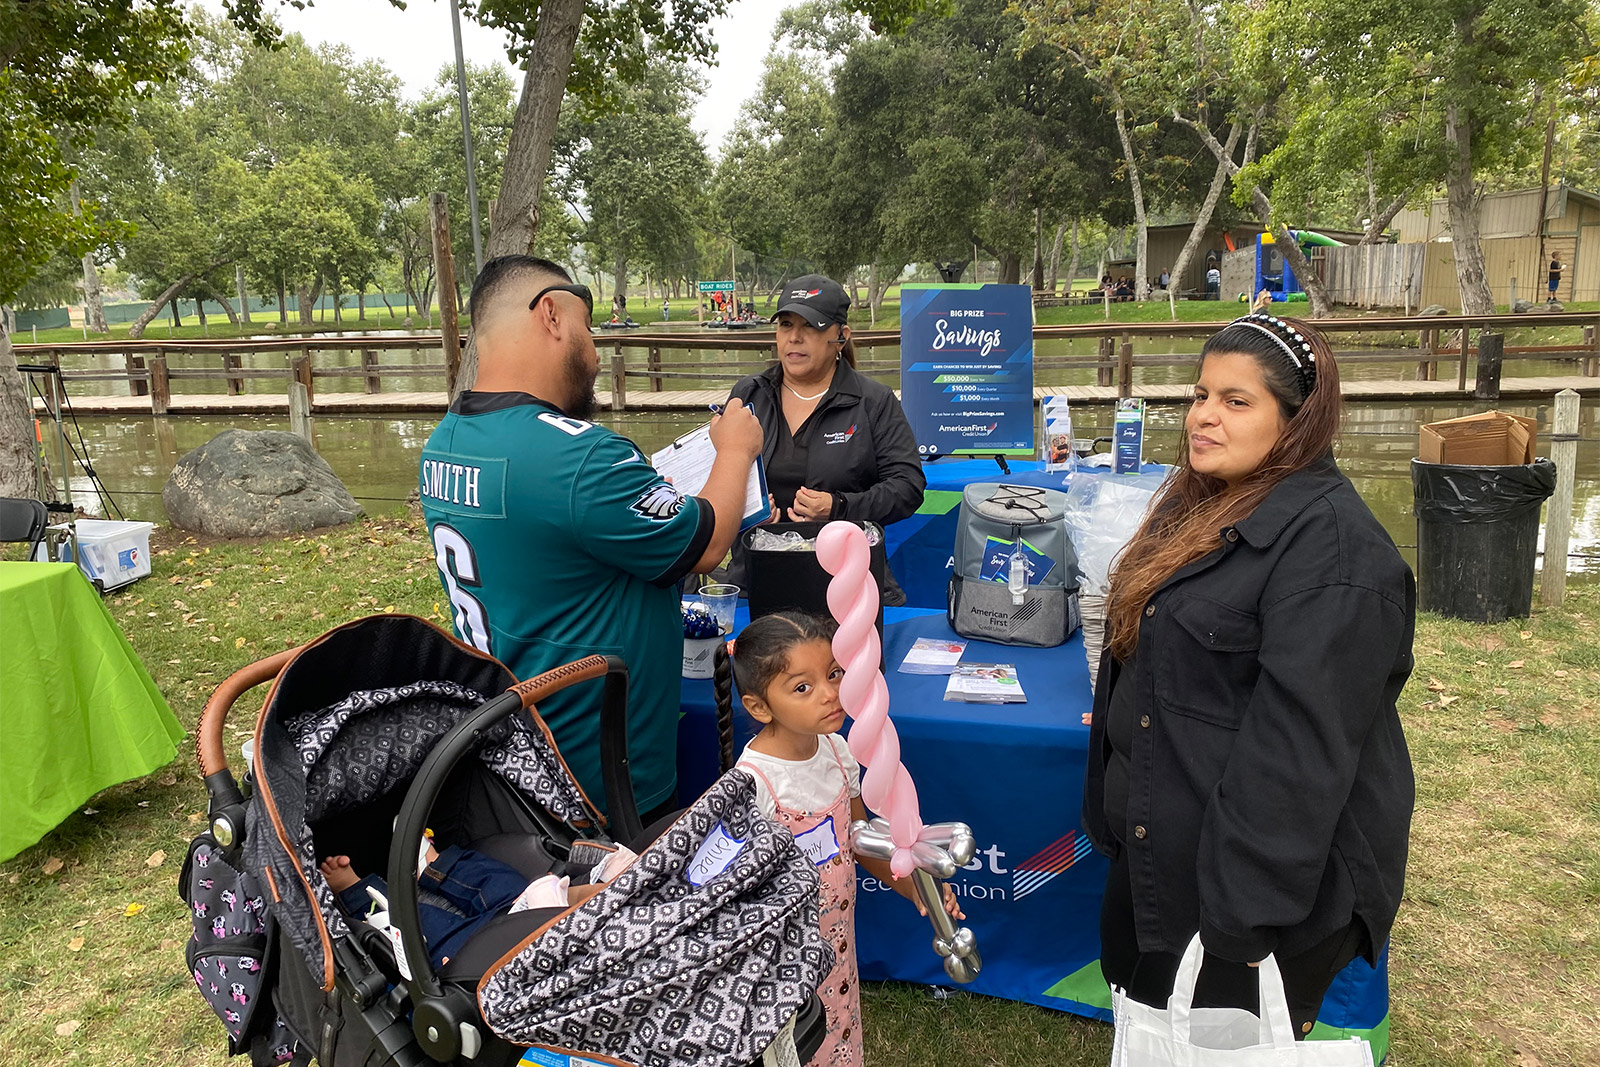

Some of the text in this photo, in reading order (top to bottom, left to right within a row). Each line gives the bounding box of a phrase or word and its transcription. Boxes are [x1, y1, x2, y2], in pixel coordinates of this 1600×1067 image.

[932, 319, 1002, 357] Savings
[537, 412, 595, 436] 6
[422, 459, 481, 508] SMITH
[433, 522, 492, 657] 6
[971, 606, 1008, 618] American
[989, 617, 1008, 627] First
[803, 840, 823, 858] mily
[949, 879, 1006, 900] nion
